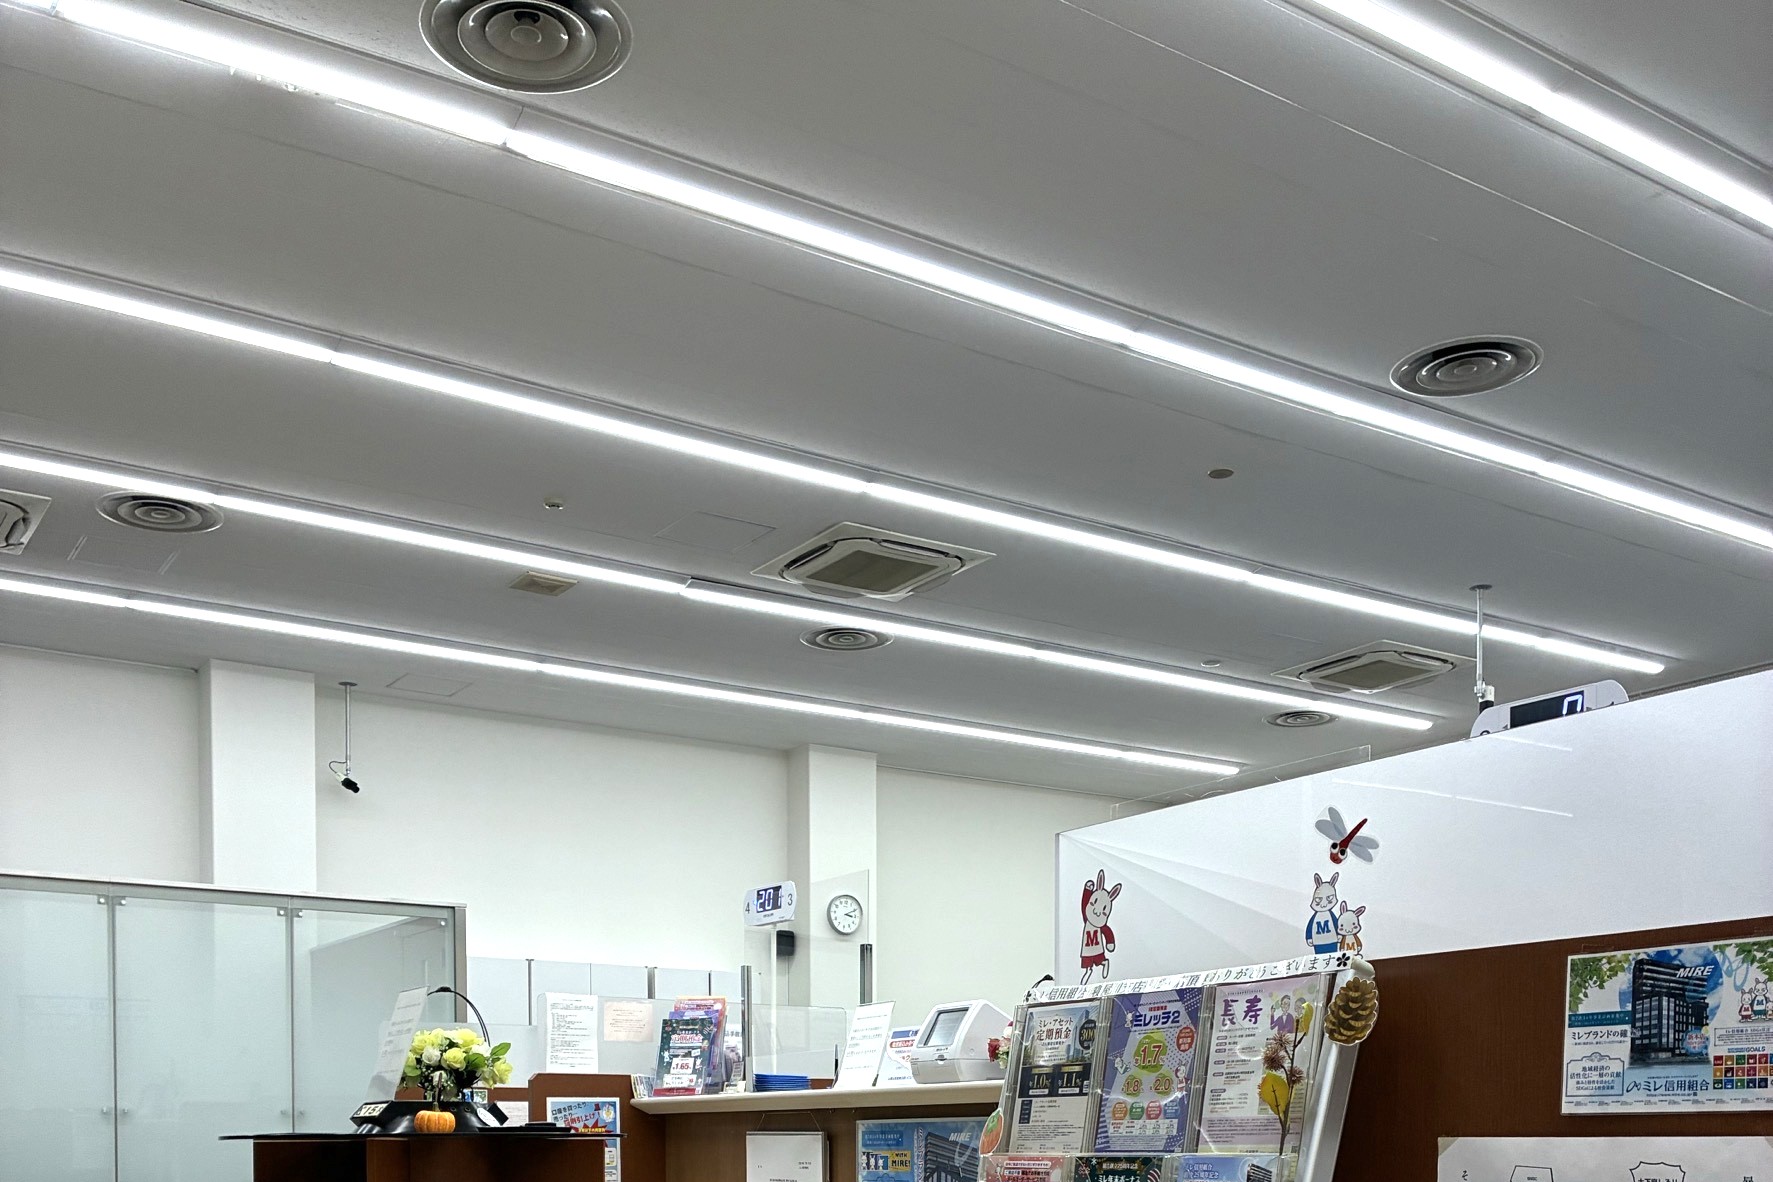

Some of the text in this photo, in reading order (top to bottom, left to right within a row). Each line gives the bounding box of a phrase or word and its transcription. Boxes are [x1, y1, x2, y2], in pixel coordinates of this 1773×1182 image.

[757, 888, 782, 912] 201
[1316, 920, 1331, 935] M
[1084, 930, 1101, 947] M
[1346, 942, 1356, 951] M
[1676, 966, 1715, 978] MIRE
[1220, 995, 1263, 1027] 長寿
[1036, 1027, 1072, 1042] 定期預金
[1642, 1078, 1709, 1092] ミレ信用組合
